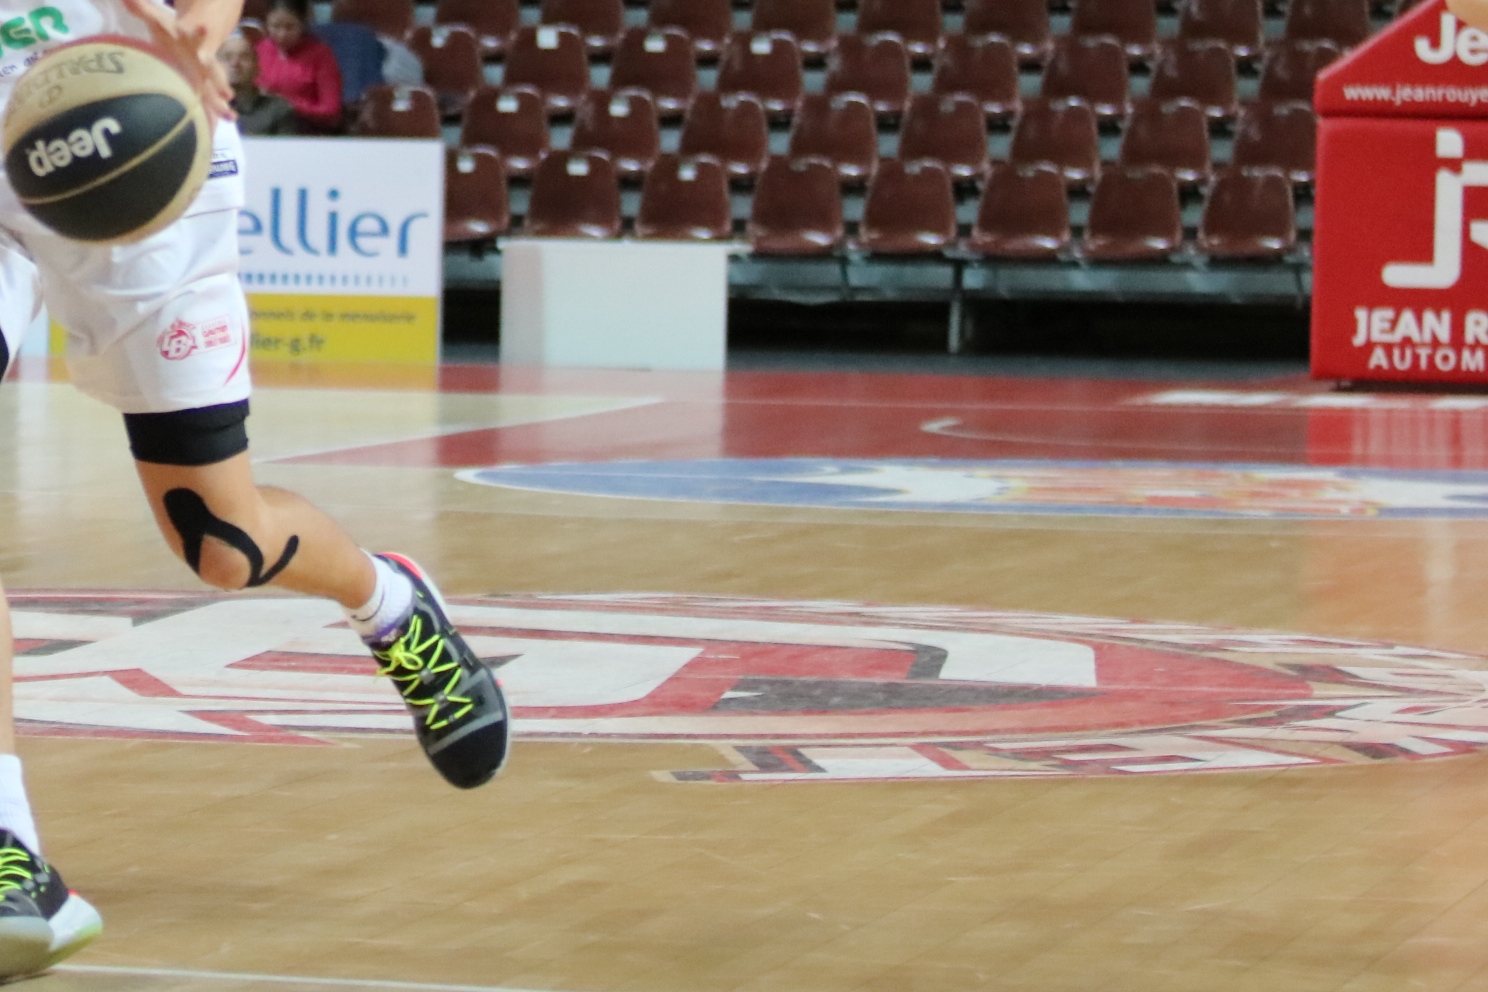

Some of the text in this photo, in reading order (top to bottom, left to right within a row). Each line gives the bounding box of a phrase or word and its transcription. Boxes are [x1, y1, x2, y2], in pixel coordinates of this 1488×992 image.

[1414, 12, 1488, 66] Je
[1343, 83, 1488, 108] www.jeanrouye
[25, 115, 123, 178] Jeep
[1352, 306, 1488, 348] JEAN R
[1367, 345, 1487, 373] AUTOM
